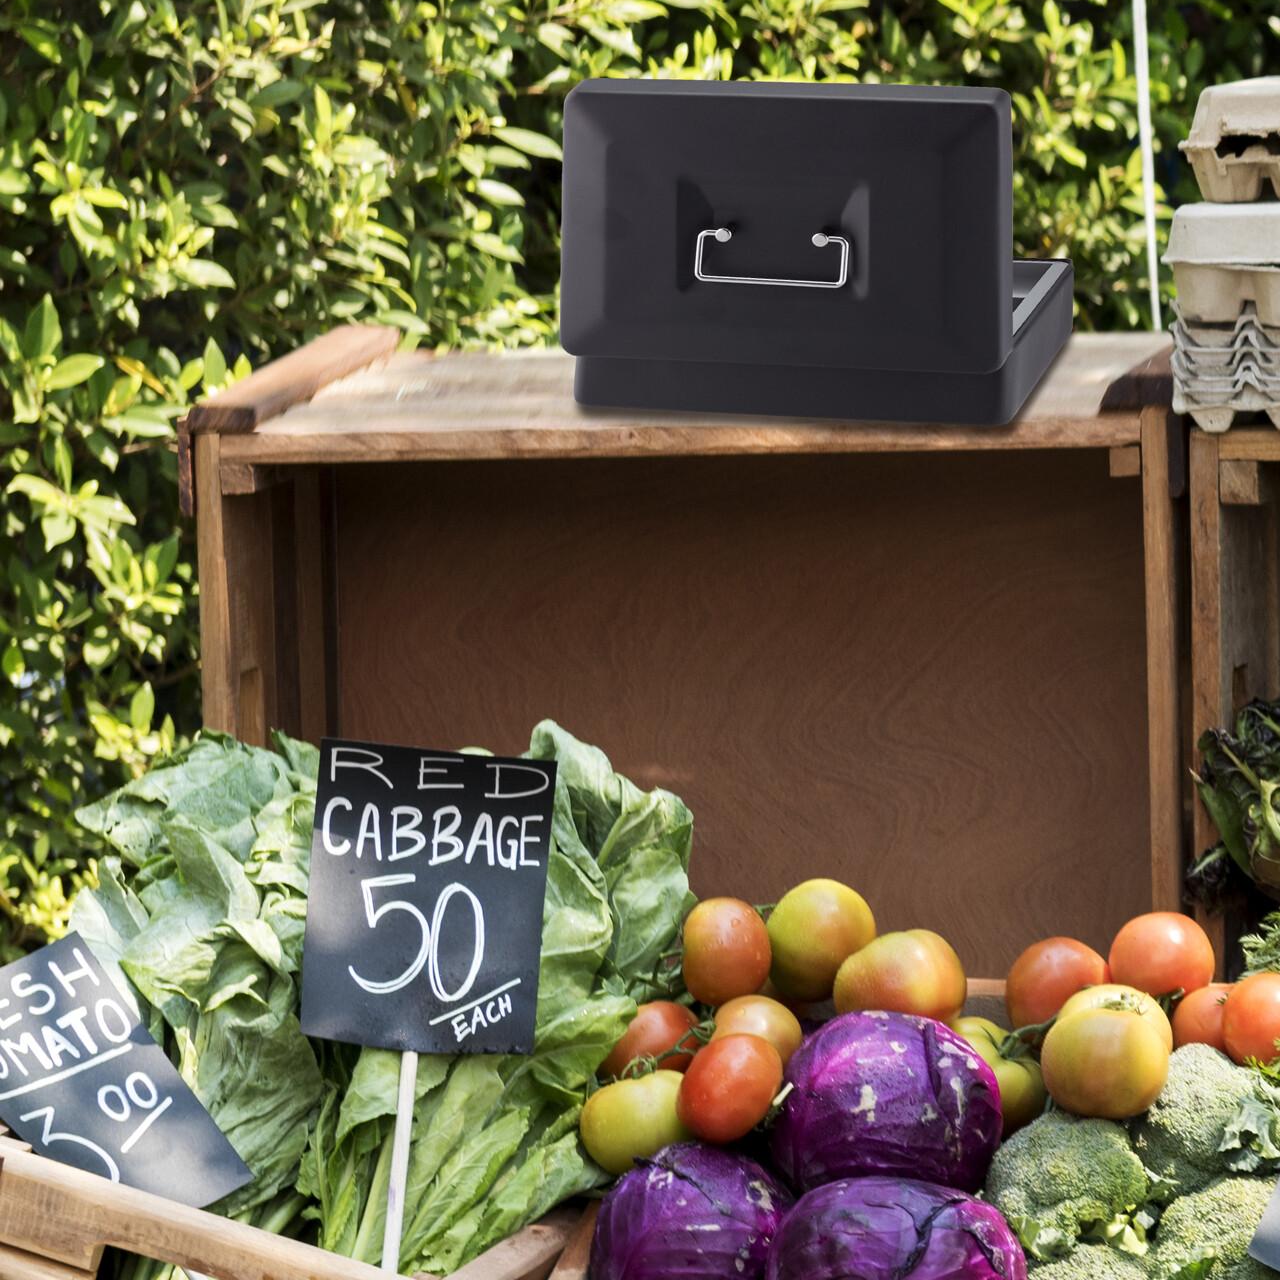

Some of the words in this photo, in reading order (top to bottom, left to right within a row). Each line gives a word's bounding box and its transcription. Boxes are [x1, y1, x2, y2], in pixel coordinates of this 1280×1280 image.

[331, 747, 550, 799] RED
[322, 796, 544, 871] CABBAGE
[348, 872, 485, 1003] 50
[0, 998, 132, 1080] MATO
[451, 993, 513, 1042] EACH
[97, 1071, 158, 1122] 00
